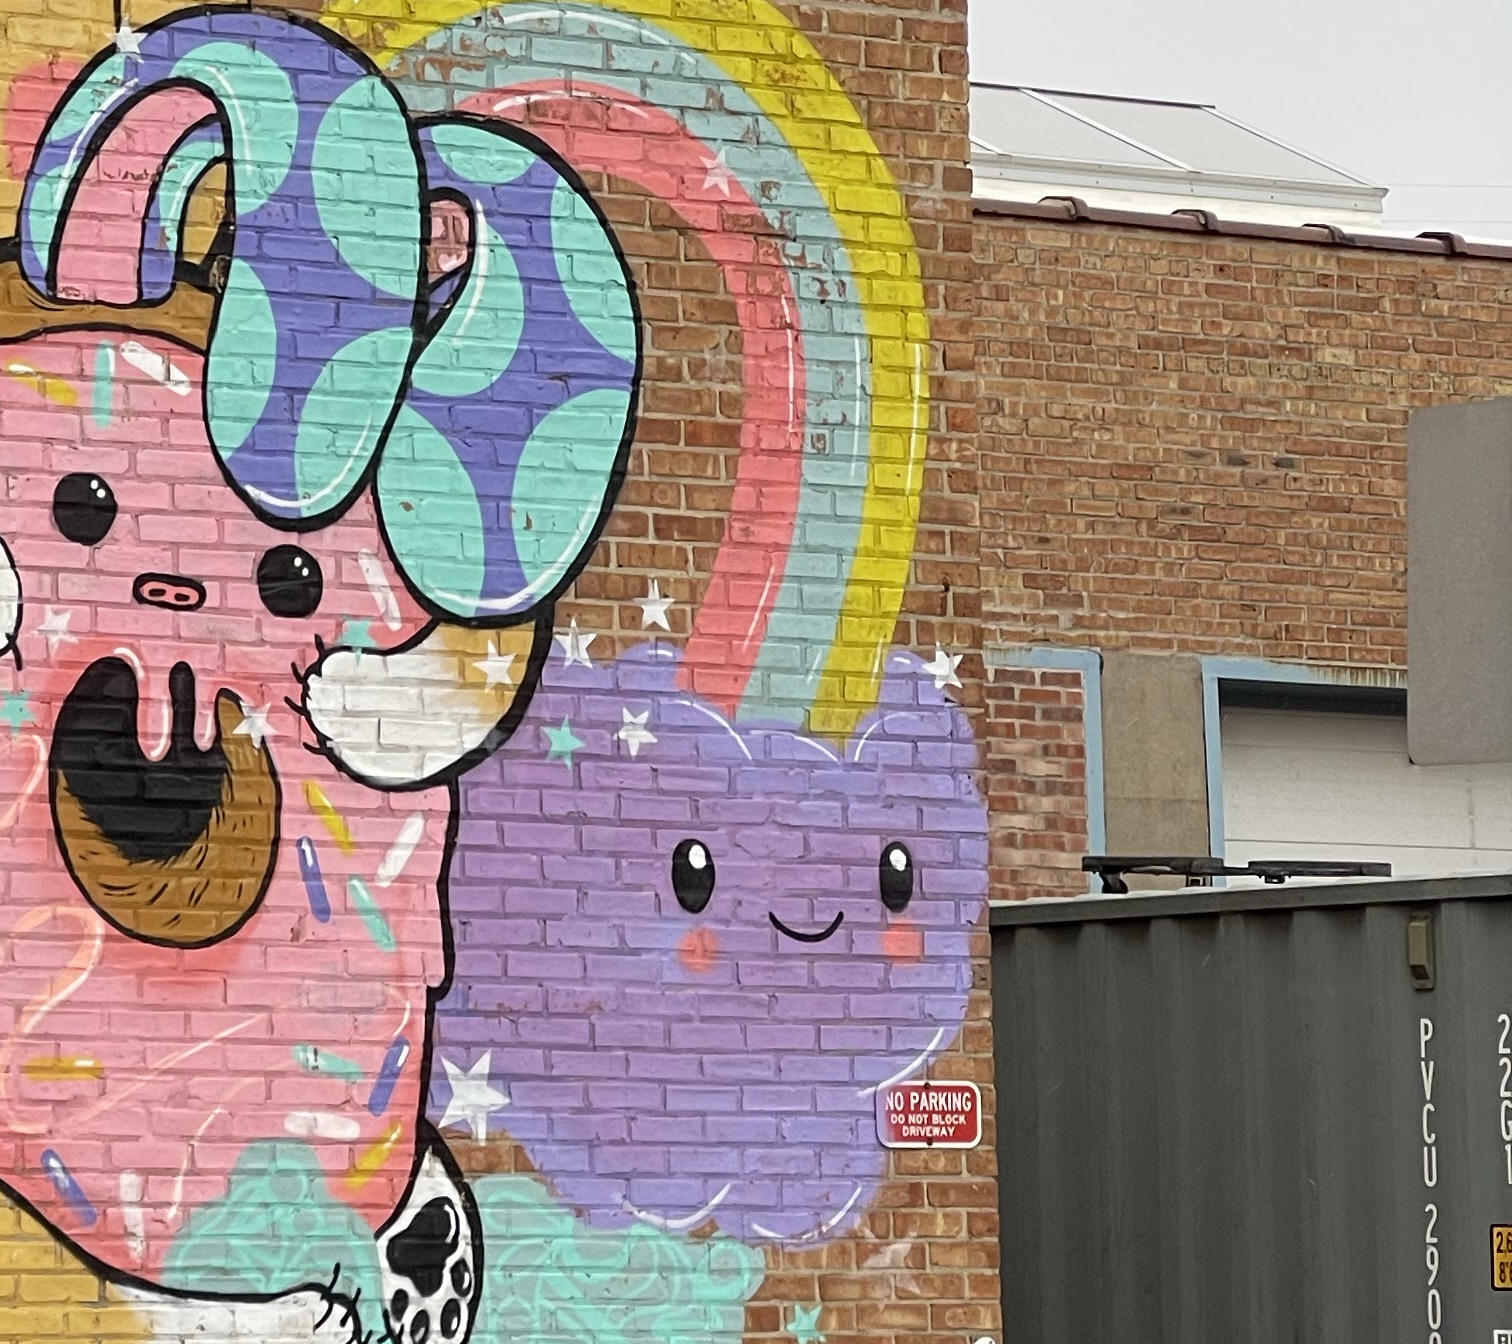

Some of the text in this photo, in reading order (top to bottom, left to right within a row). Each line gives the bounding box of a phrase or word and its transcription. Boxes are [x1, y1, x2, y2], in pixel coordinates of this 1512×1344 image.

[885, 1091, 972, 1111] NO PARKING
[1419, 1017, 1438, 1188] PVCU
[1497, 1013, 1512, 1185] 22G1
[890, 1113, 966, 1125] DO NOT BLOCK
[902, 1125, 956, 1137] DRIVEWAY
